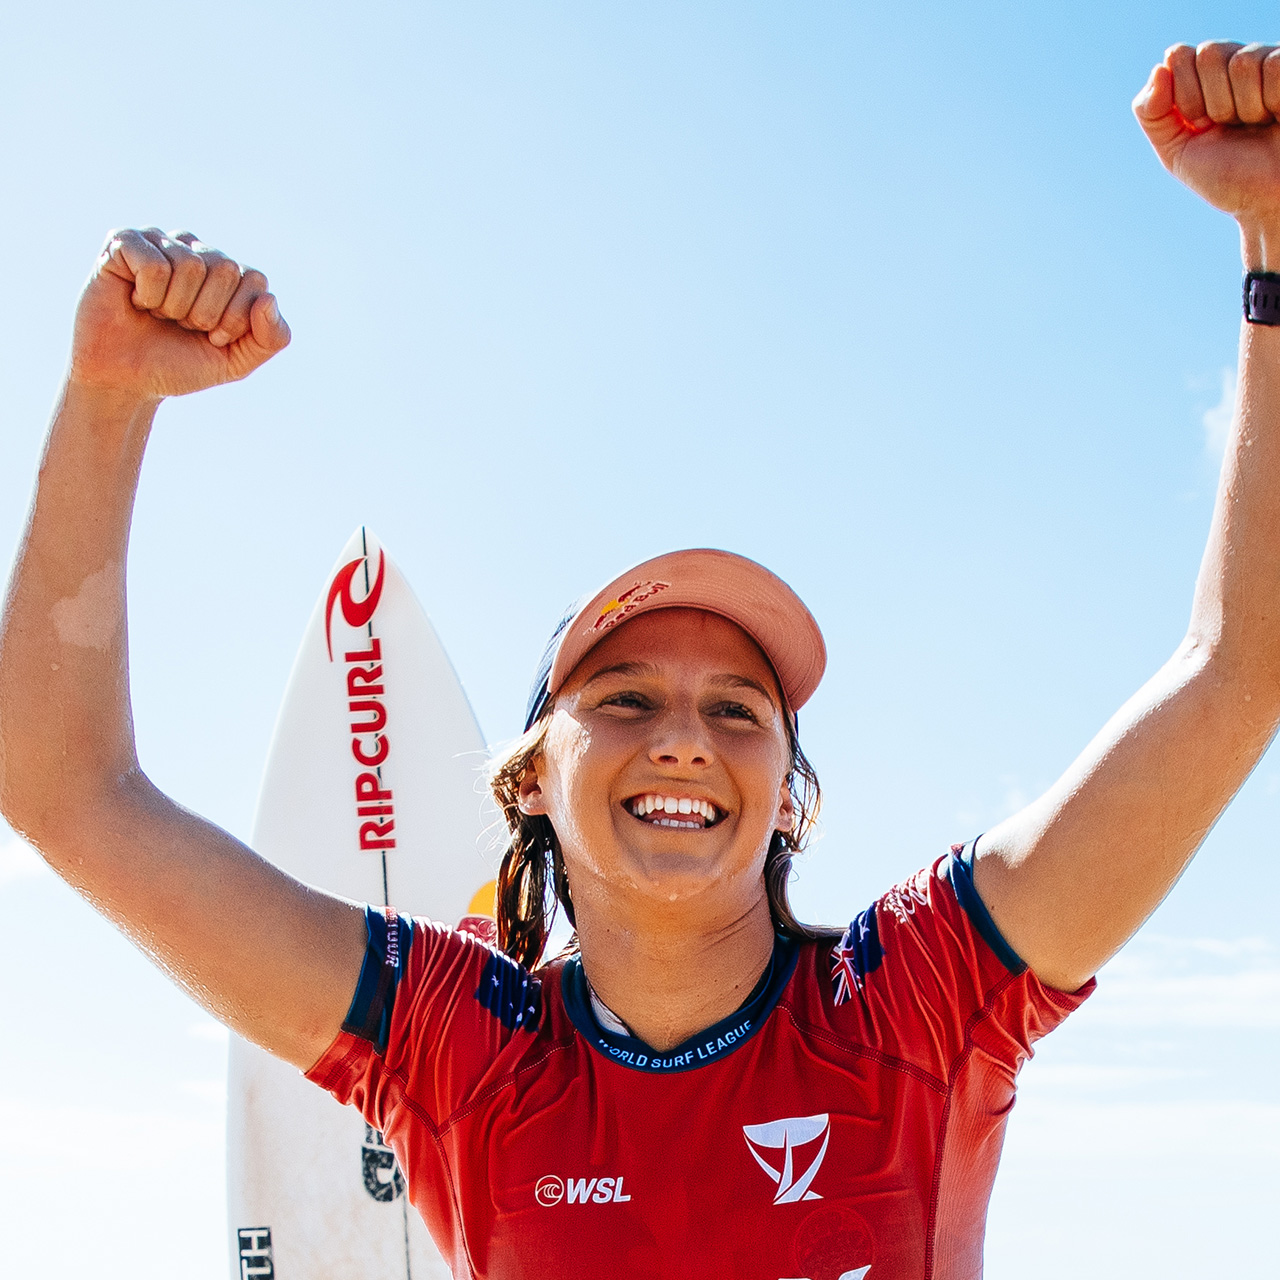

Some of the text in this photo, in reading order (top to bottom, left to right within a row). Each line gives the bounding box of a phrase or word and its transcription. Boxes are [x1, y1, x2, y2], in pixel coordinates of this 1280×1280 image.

[599, 1038, 649, 1068] ORLD
[650, 1050, 695, 1069] SURF
[566, 1176, 632, 1204] WSL
